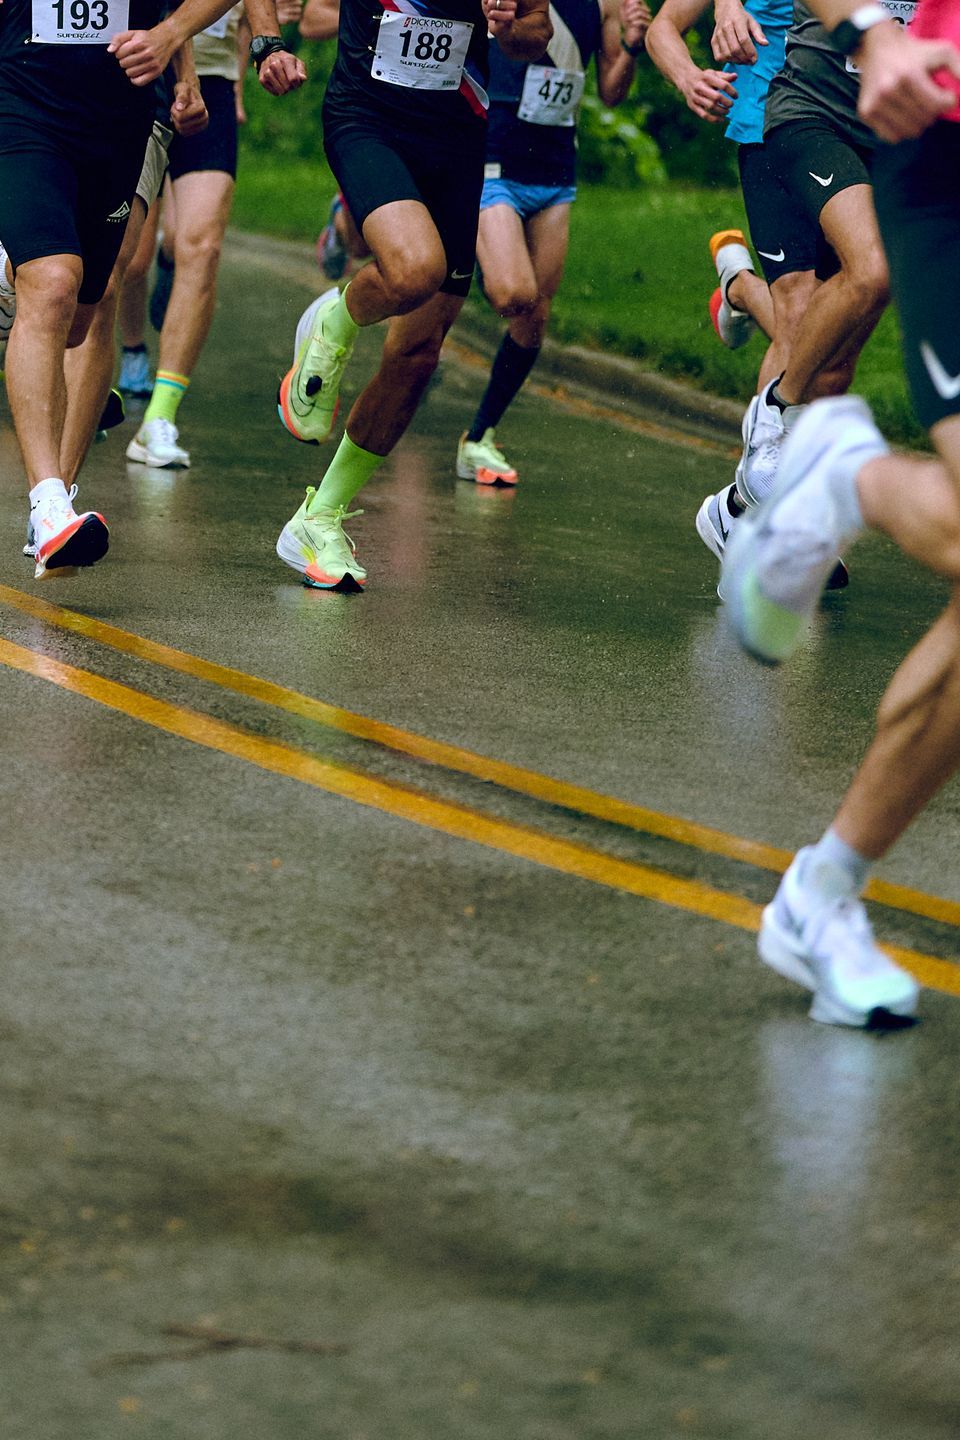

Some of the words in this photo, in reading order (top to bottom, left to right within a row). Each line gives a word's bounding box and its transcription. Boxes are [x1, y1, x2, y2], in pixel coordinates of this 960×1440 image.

[51, 0, 109, 31] 193
[881, 1, 899, 11] DICK
[411, 17, 430, 27] DICK
[430, 20, 454, 29] POND
[399, 30, 453, 63] 188
[538, 79, 574, 105] 473
